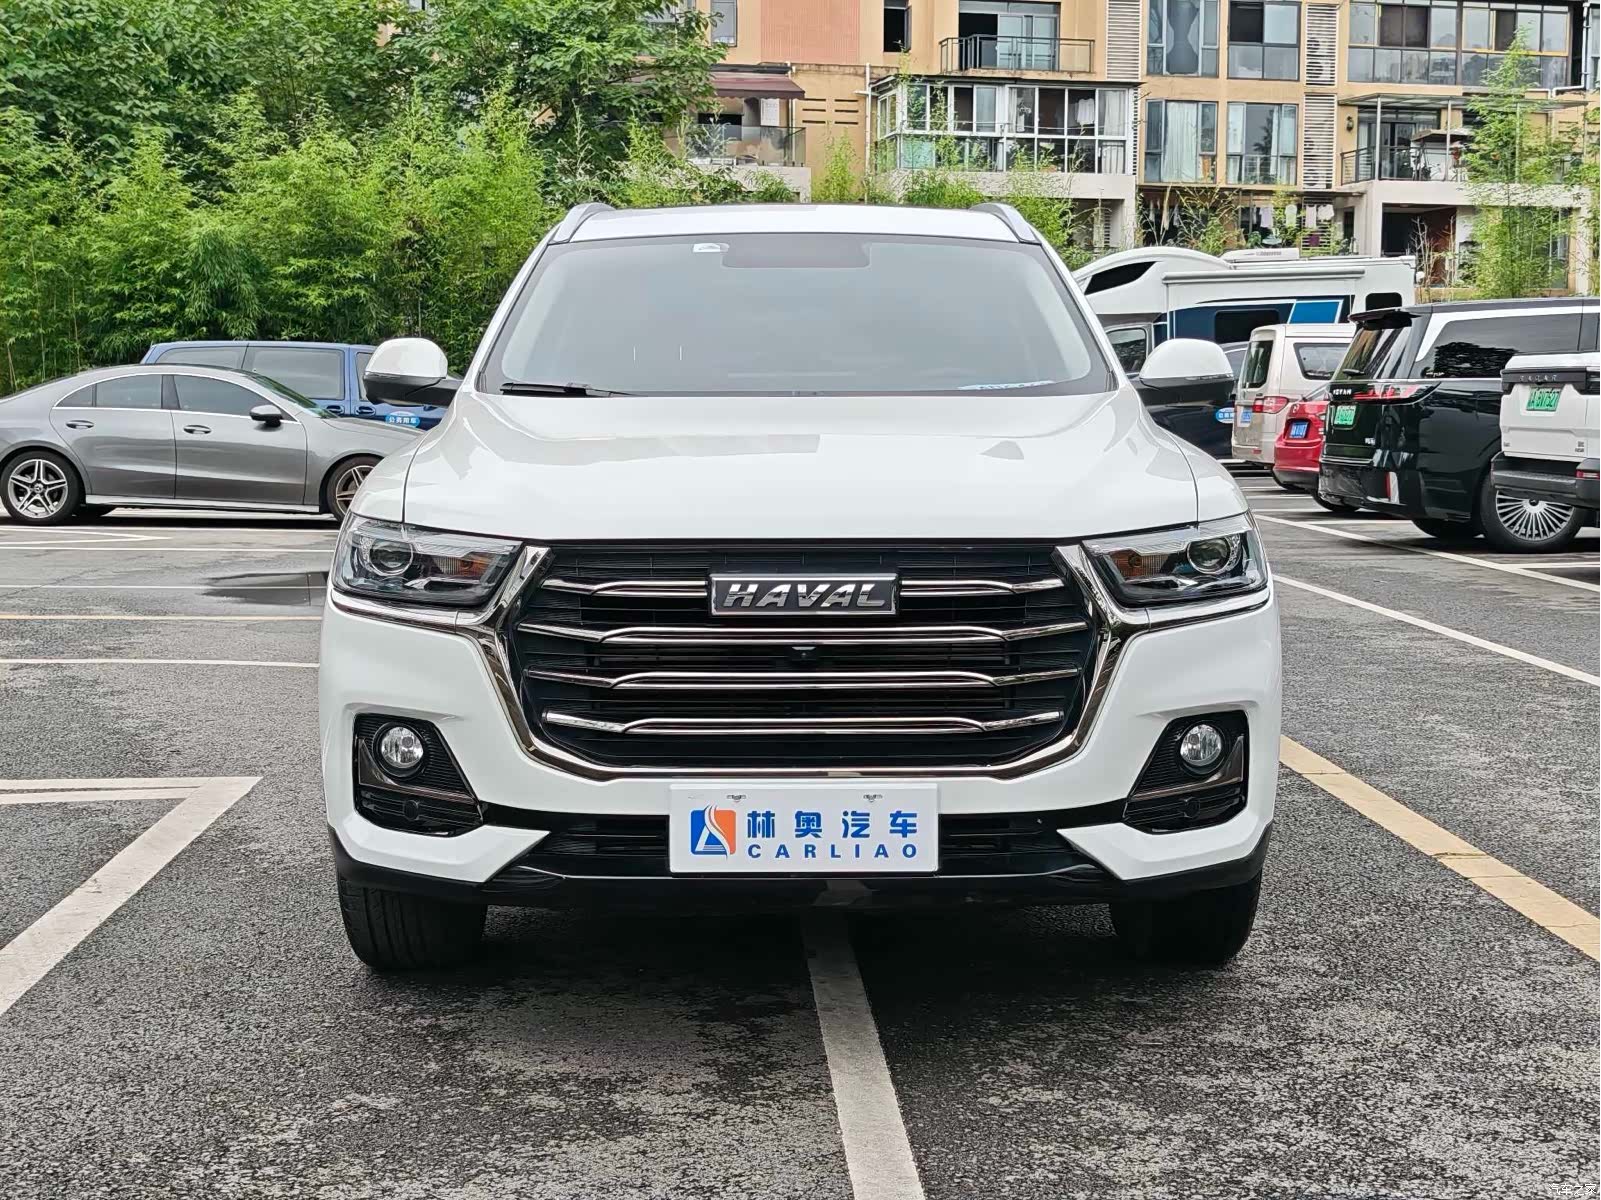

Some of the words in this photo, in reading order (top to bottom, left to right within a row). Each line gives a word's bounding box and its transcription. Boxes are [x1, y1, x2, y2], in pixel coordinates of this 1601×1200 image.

[723, 583, 886, 607] HAVAL
[747, 810, 918, 838] 林奥汽车
[747, 843, 918, 859] CARLIAO
